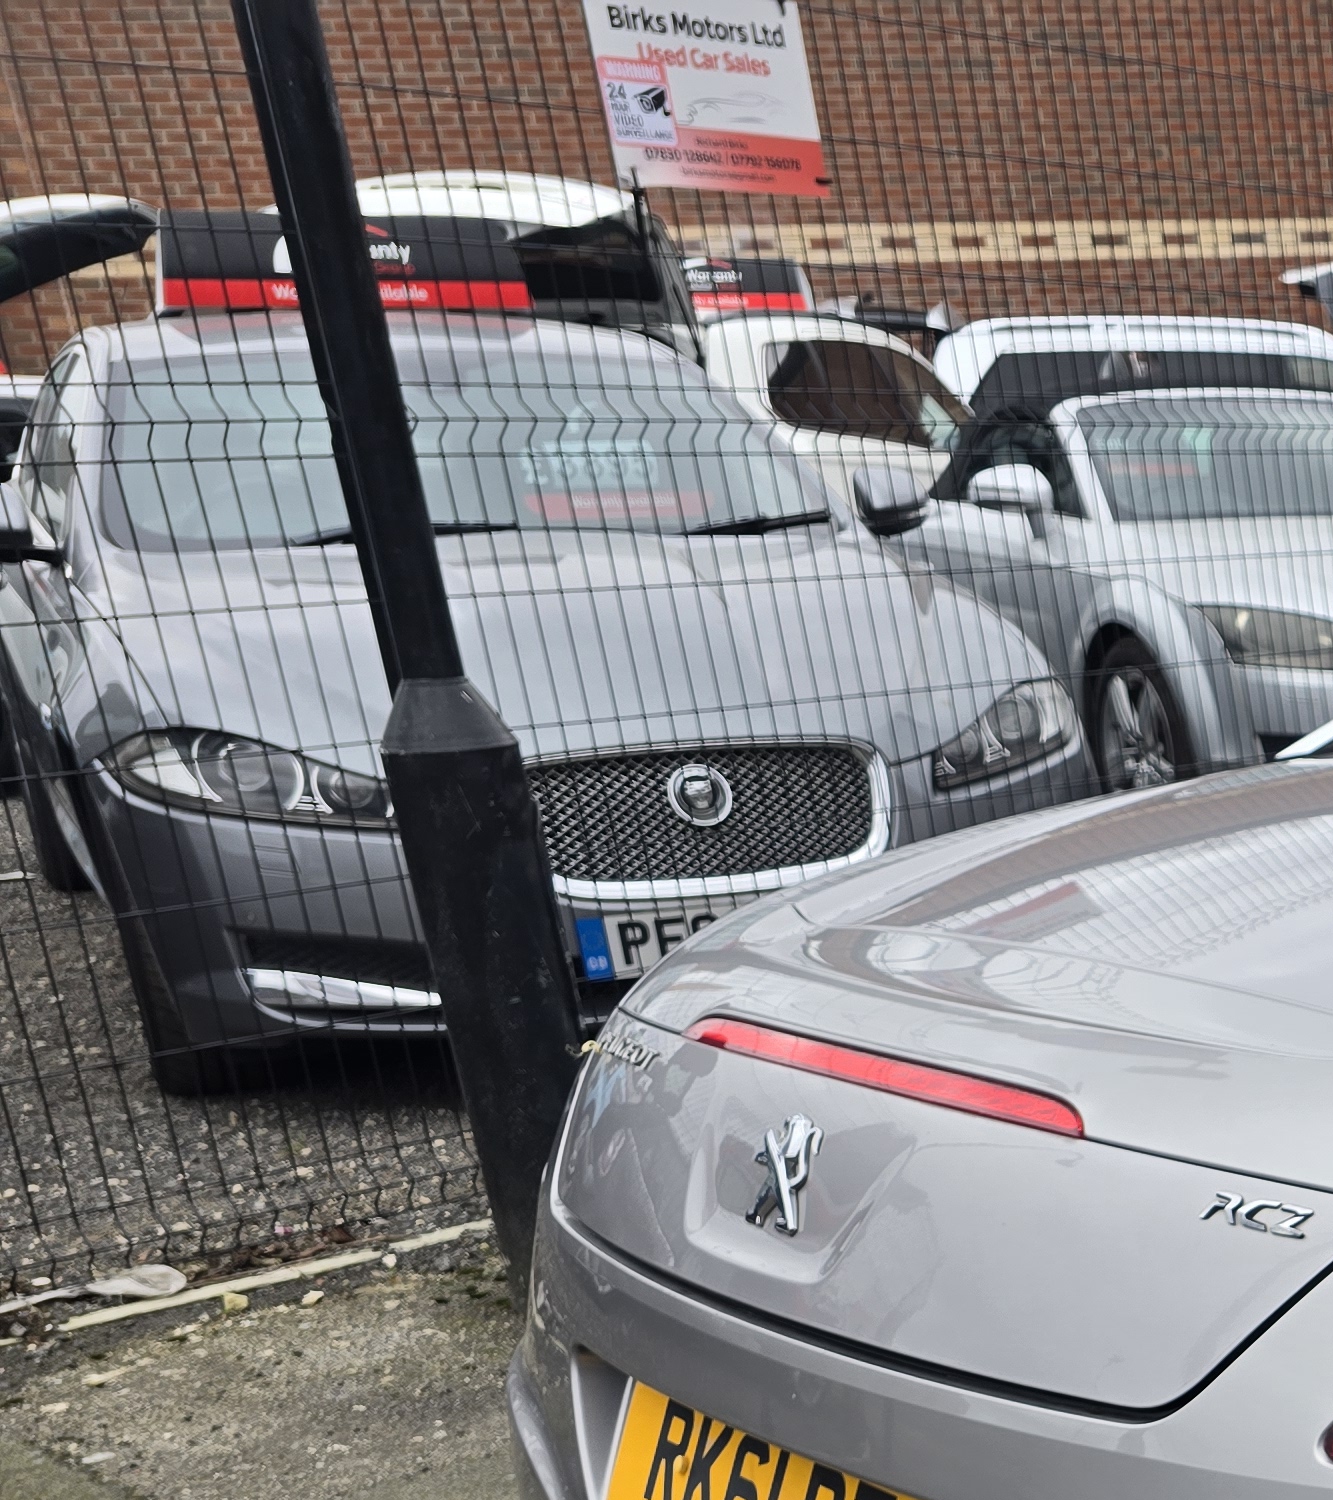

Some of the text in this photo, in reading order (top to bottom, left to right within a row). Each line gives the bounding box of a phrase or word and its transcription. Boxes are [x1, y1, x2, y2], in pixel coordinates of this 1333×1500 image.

[607, 5, 787, 48] Birks Motors Ltd
[637, 41, 771, 77] Used Car Sales
[1199, 1190, 1314, 1239] RCZ
